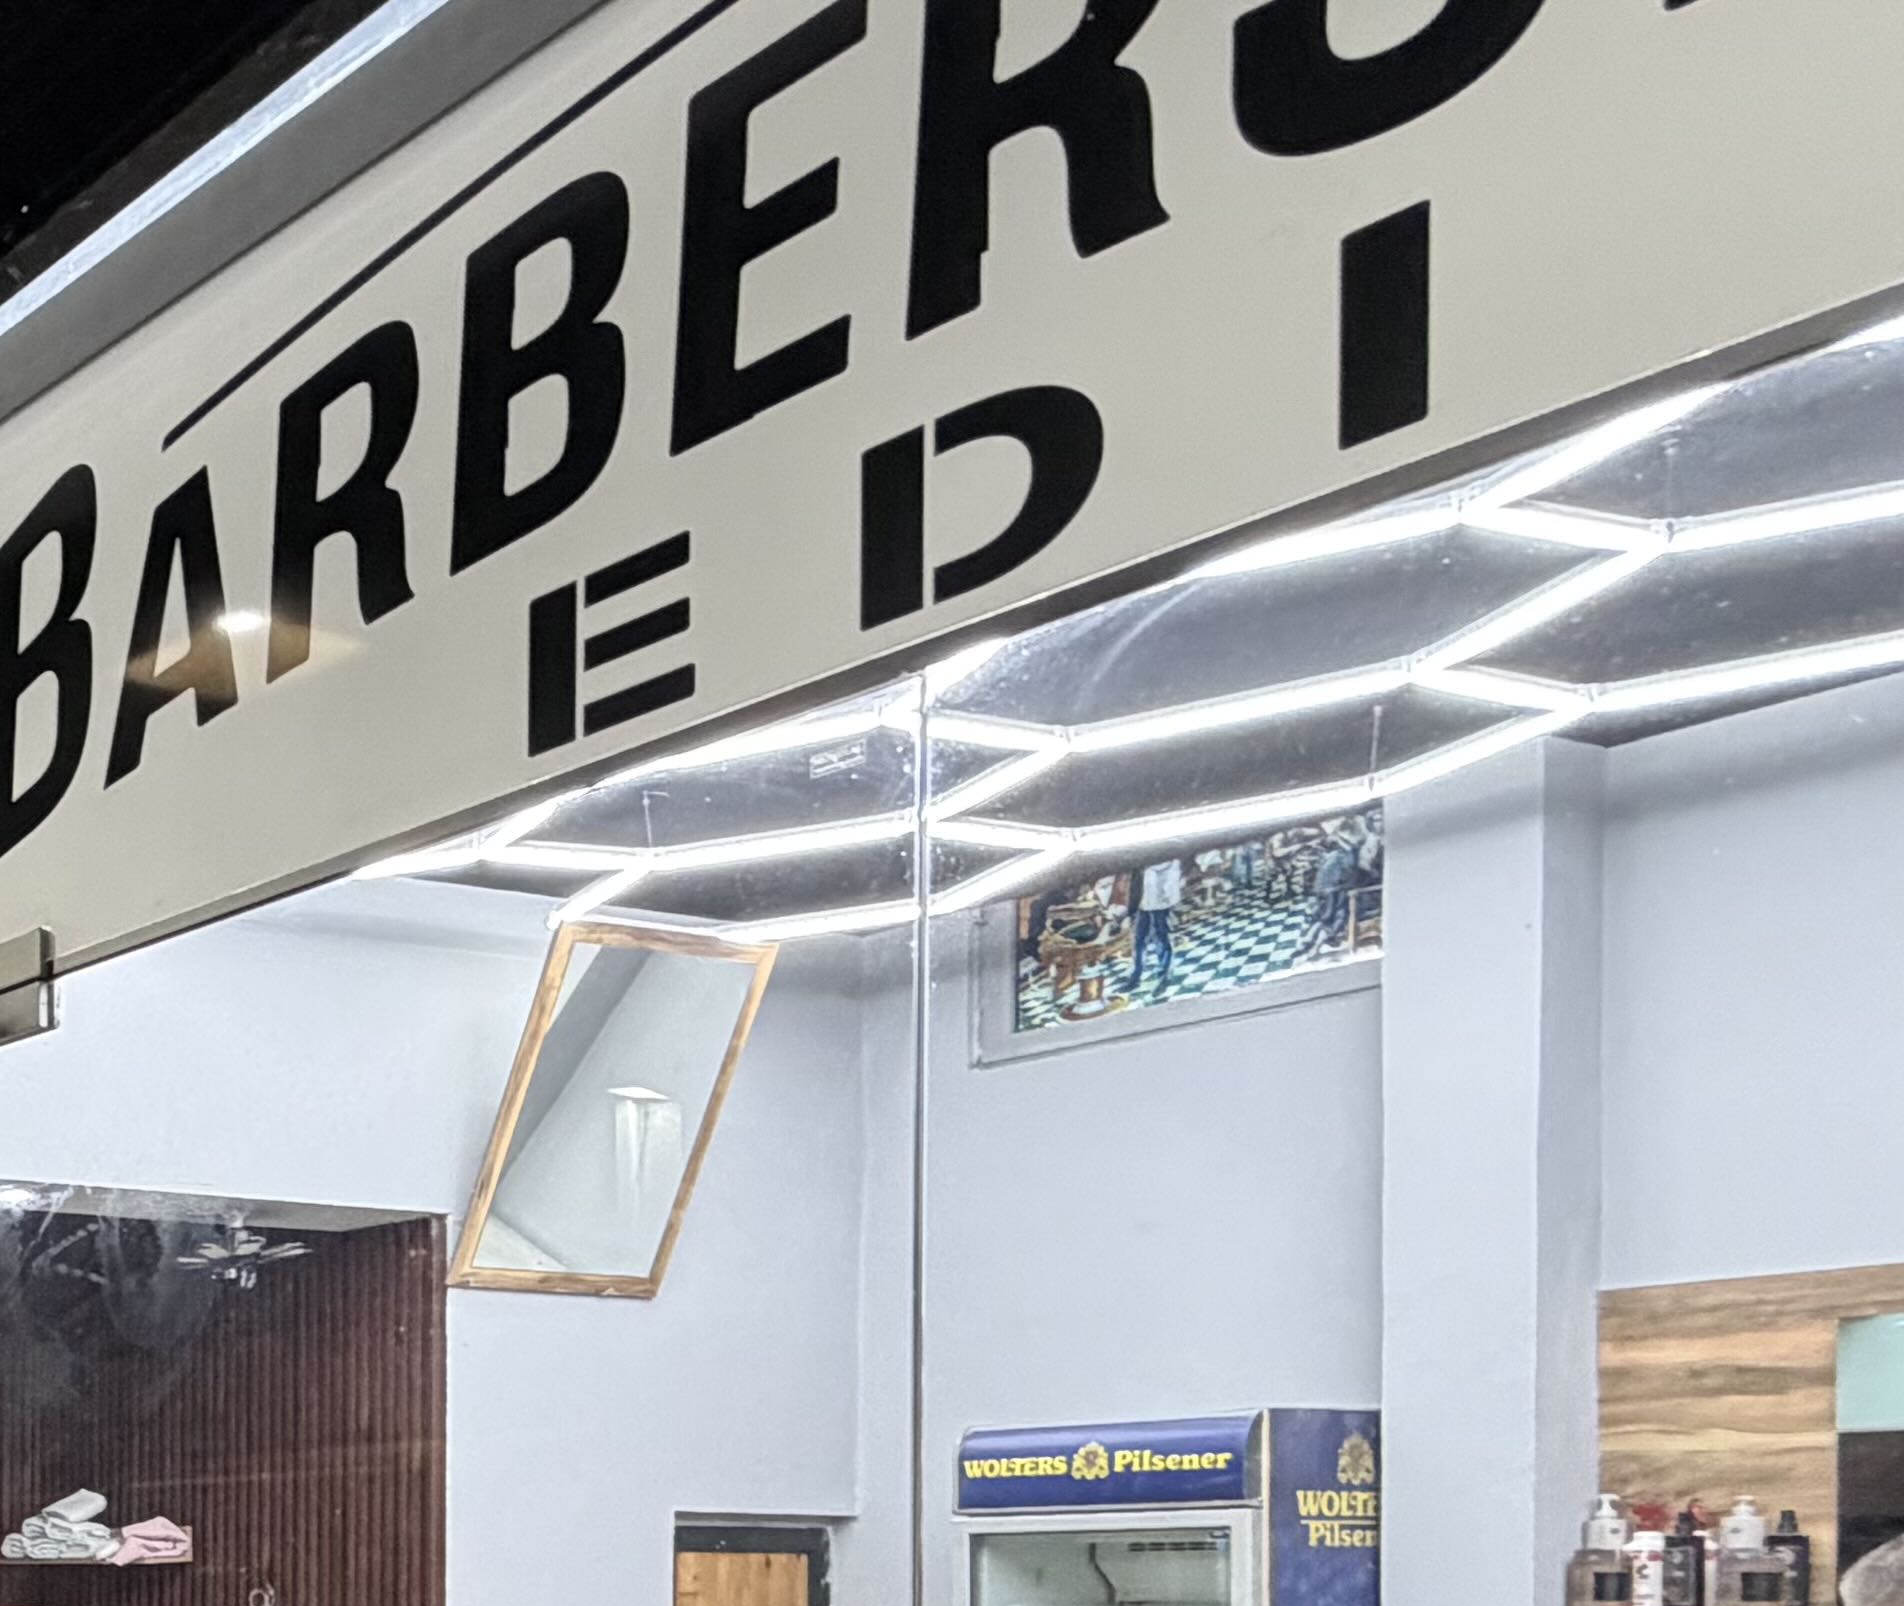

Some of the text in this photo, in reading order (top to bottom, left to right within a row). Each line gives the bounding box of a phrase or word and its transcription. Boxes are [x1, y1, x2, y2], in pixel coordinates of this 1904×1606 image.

[525, 199, 1430, 757] EDI
[963, 1449, 1233, 1479] WOLTERS Pilsener
